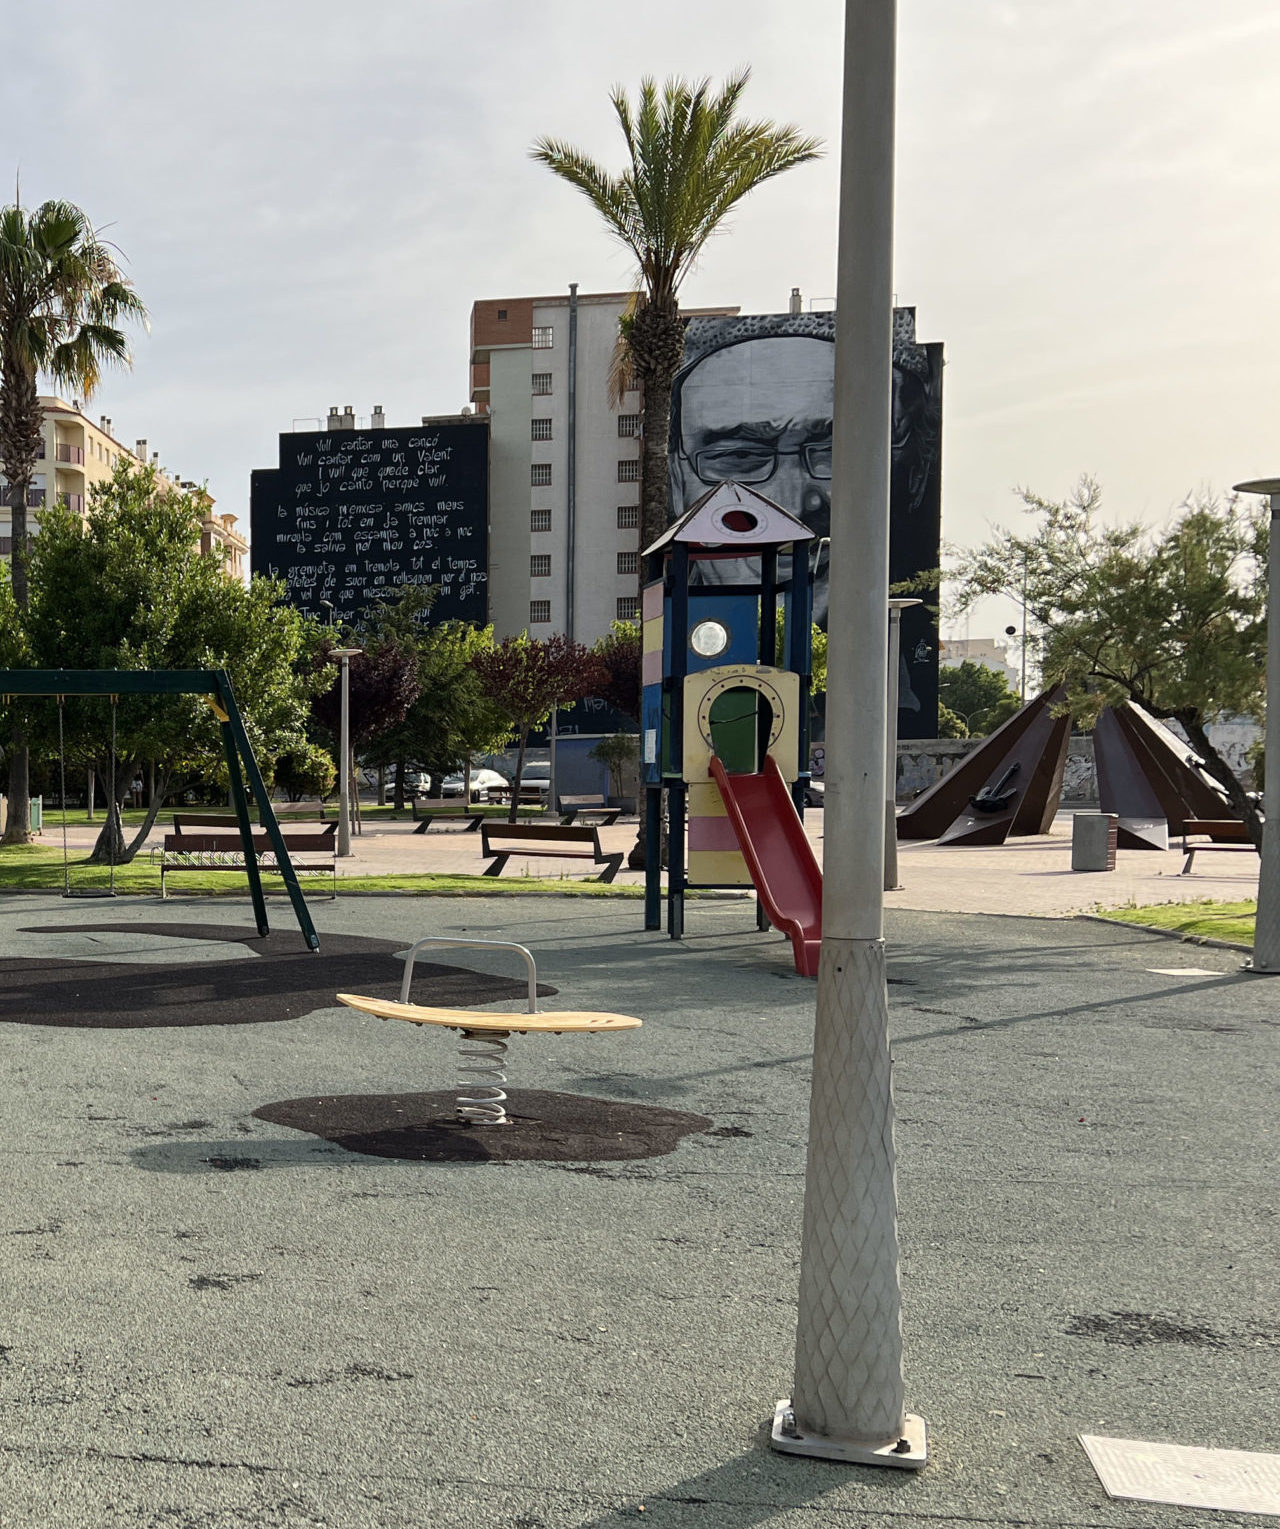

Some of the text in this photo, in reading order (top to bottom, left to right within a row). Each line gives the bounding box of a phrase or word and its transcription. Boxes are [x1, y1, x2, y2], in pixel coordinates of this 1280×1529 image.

[316, 438, 332, 452] Vull
[340, 435, 373, 451] cantar
[382, 439, 399, 449] una
[318, 452, 352, 465] cantar
[361, 453, 381, 463] com
[392, 452, 405, 463] un
[351, 467, 369, 481] que
[417, 462, 440, 475] clar
[295, 483, 312, 499] que
[340, 478, 373, 491] canto
[296, 502, 330, 516] música
[394, 502, 425, 513] amics
[437, 500, 464, 511] meus
[360, 517, 374, 527] em
[323, 532, 342, 542] com
[423, 527, 440, 541] poc
[457, 527, 472, 540] poc
[314, 541, 346, 553] saliva
[432, 556, 440, 569] el
[324, 573, 336, 587] de
[345, 576, 367, 586] suor
[301, 587, 312, 600] vol
[338, 588, 355, 604] que
